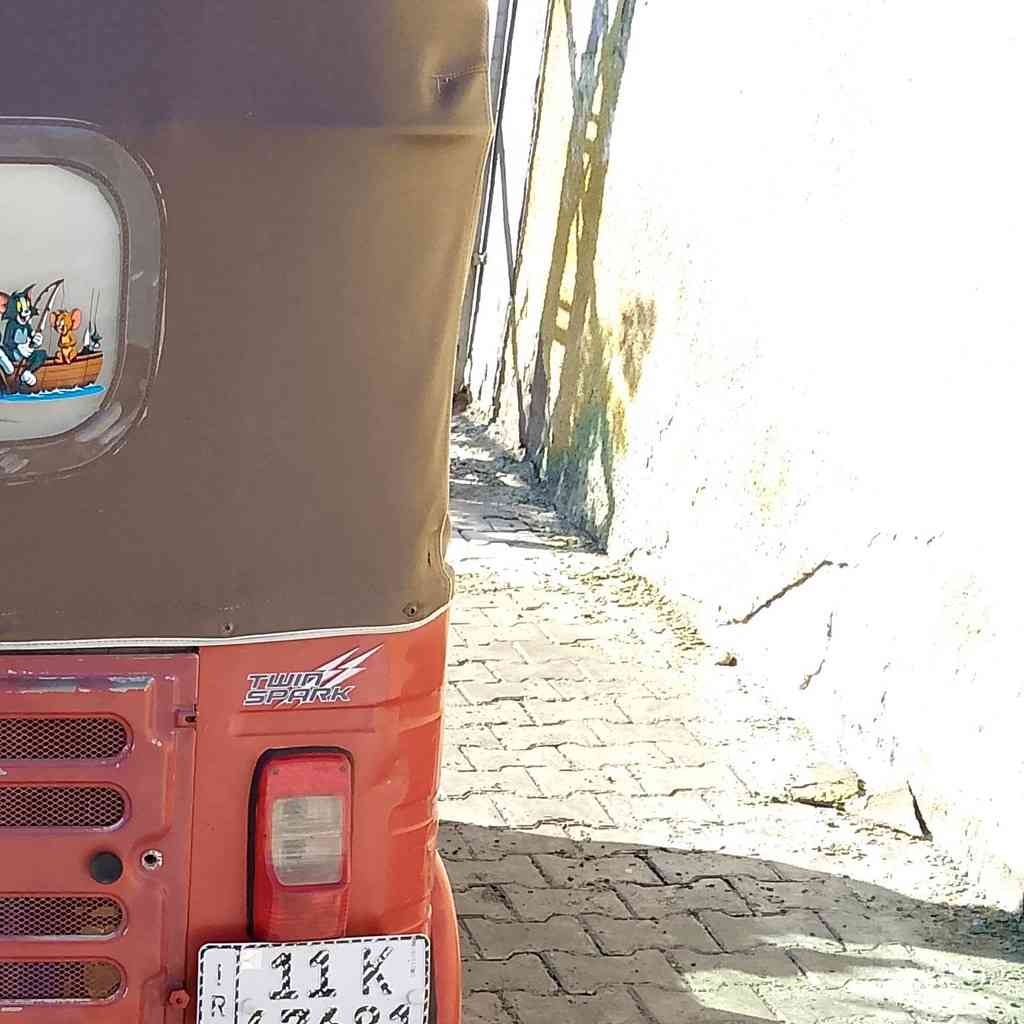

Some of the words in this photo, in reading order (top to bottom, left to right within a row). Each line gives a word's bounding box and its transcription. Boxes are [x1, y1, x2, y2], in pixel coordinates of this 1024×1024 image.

[248, 672, 324, 690] TWIN
[244, 686, 355, 706] SPARK
[269, 949, 338, 1000] 11
[362, 945, 393, 995] K
